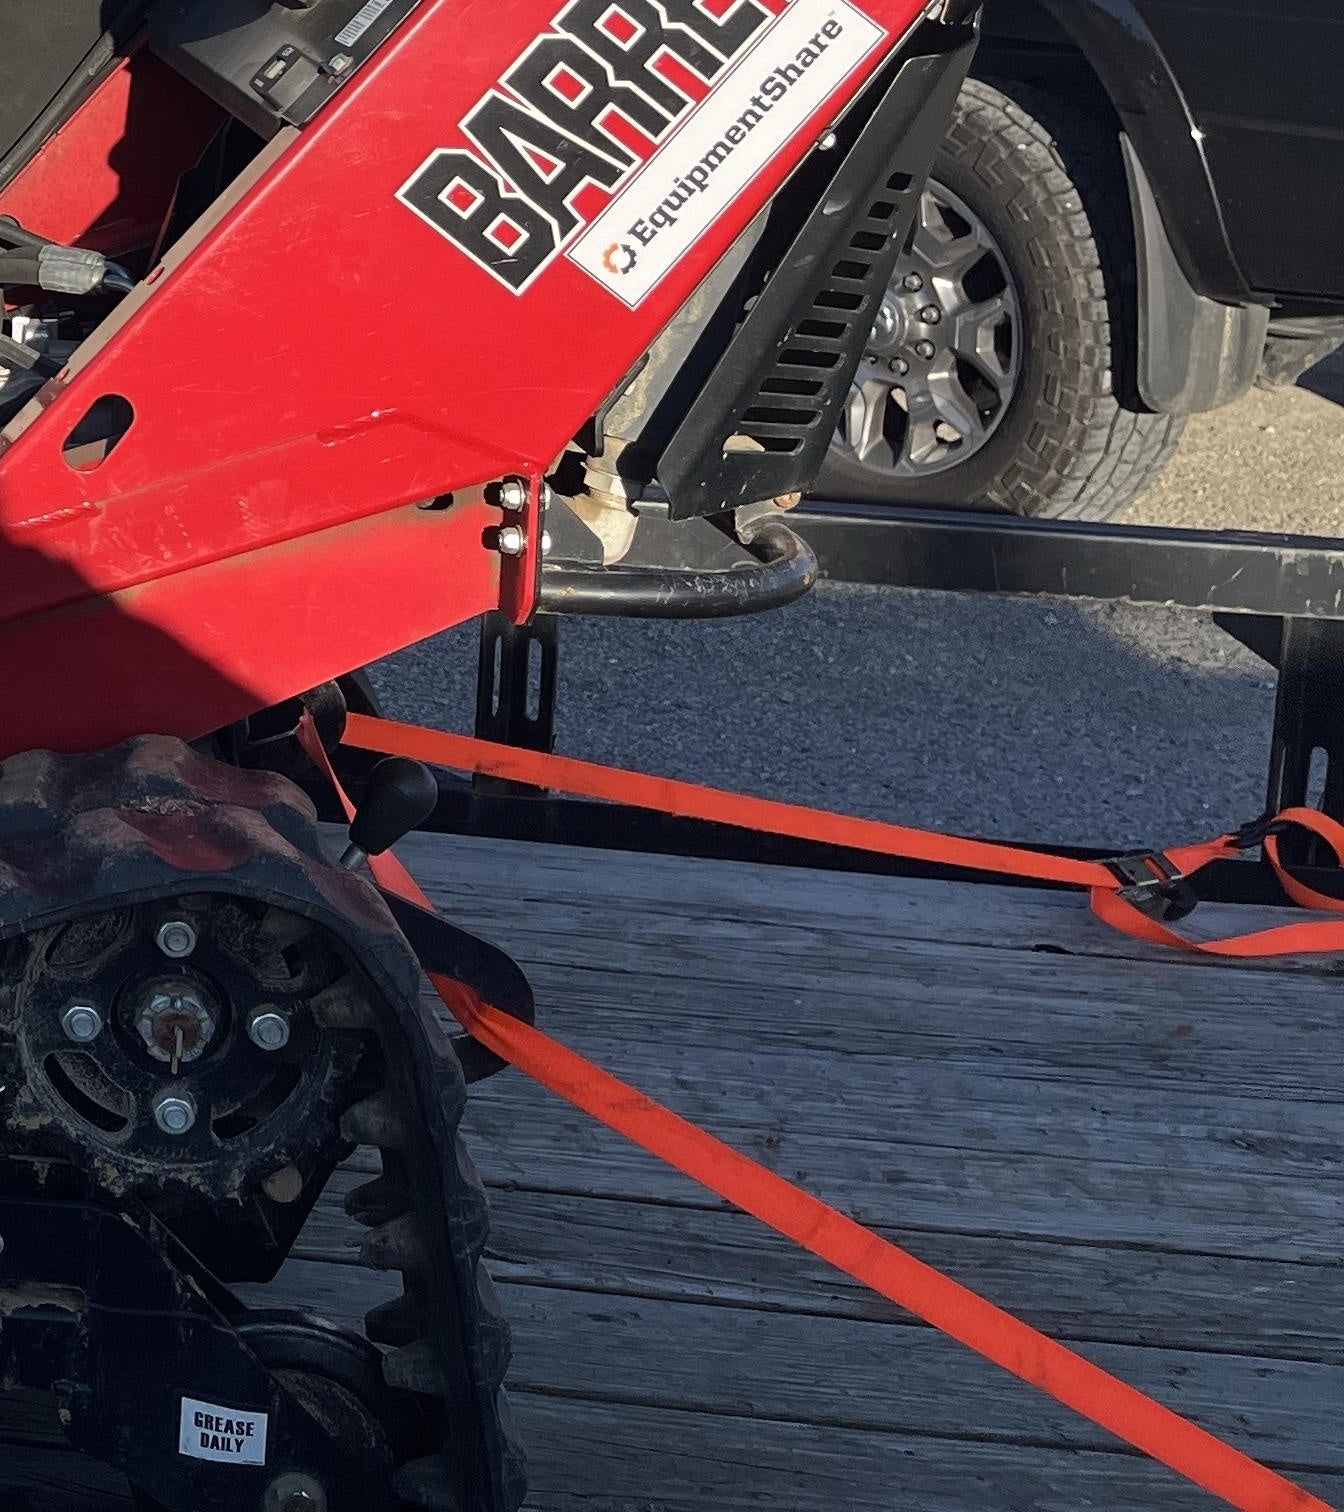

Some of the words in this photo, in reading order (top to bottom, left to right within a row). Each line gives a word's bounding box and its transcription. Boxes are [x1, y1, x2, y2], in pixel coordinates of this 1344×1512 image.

[627, 16, 844, 247] EquipmentShare
[194, 1411, 255, 1437] GREASE
[200, 1431, 245, 1453] DAILY
